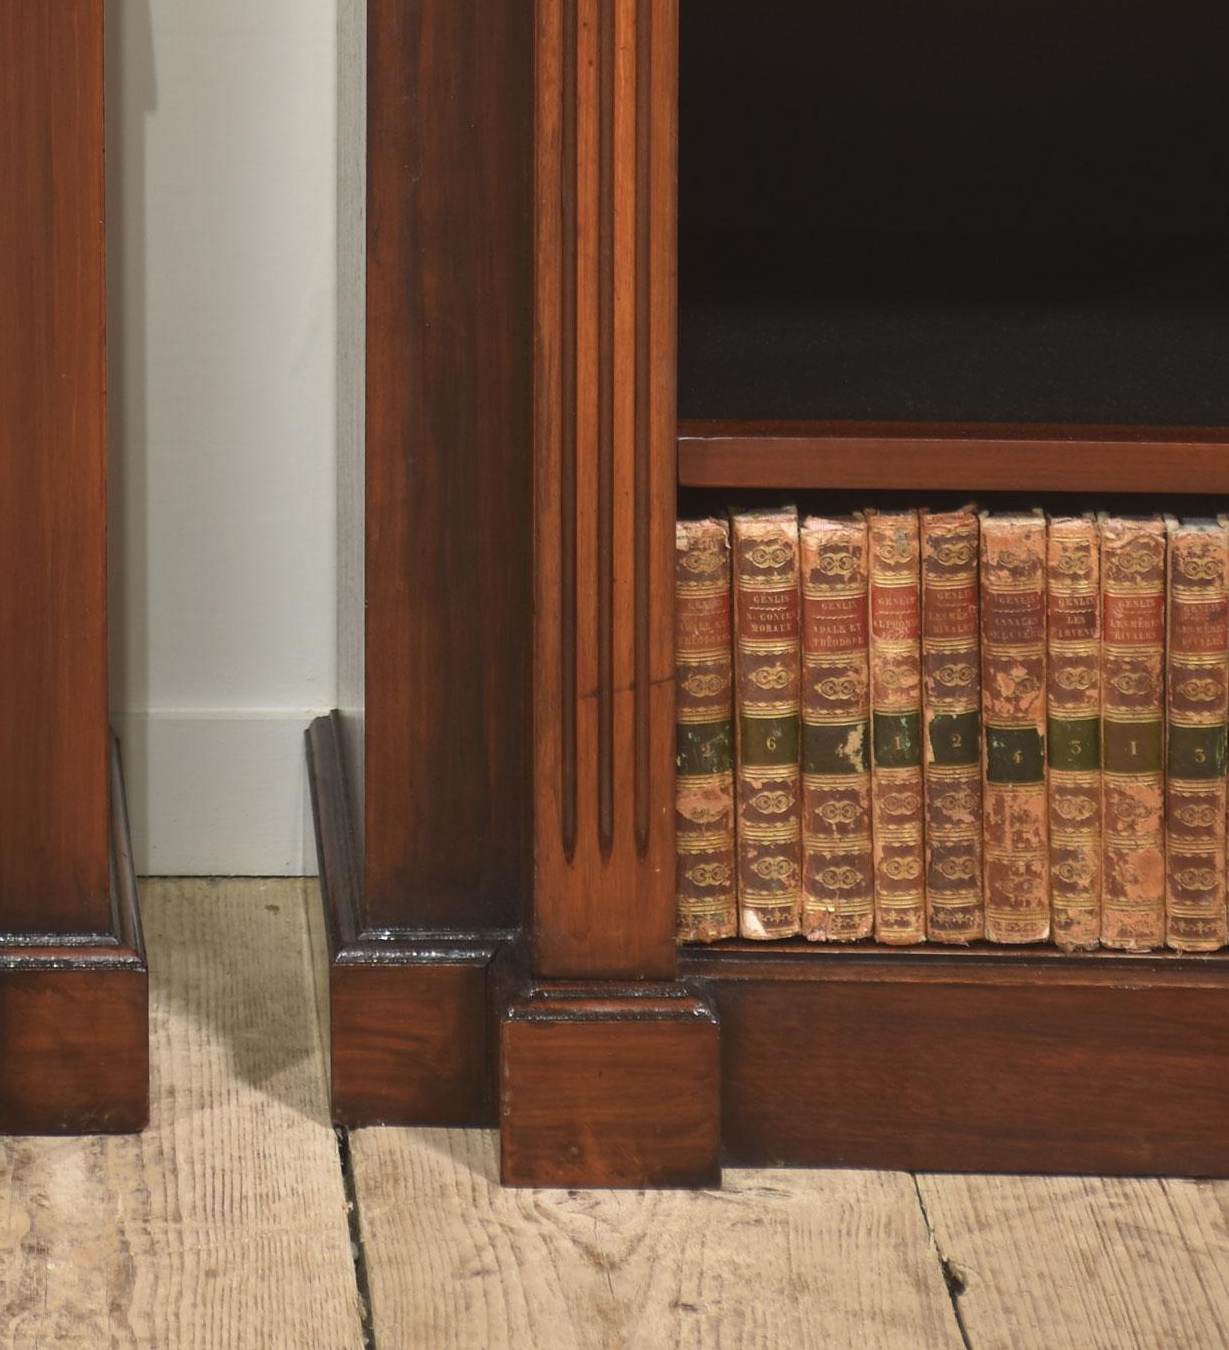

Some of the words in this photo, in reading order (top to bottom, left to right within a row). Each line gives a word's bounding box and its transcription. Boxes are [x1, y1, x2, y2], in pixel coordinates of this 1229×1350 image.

[753, 594, 791, 604] GENLIS
[766, 737, 777, 751] 6
[951, 734, 962, 748] 2
[1130, 741, 1138, 756] 1
[1013, 750, 1023, 764] 4
[1194, 749, 1206, 763] 3
